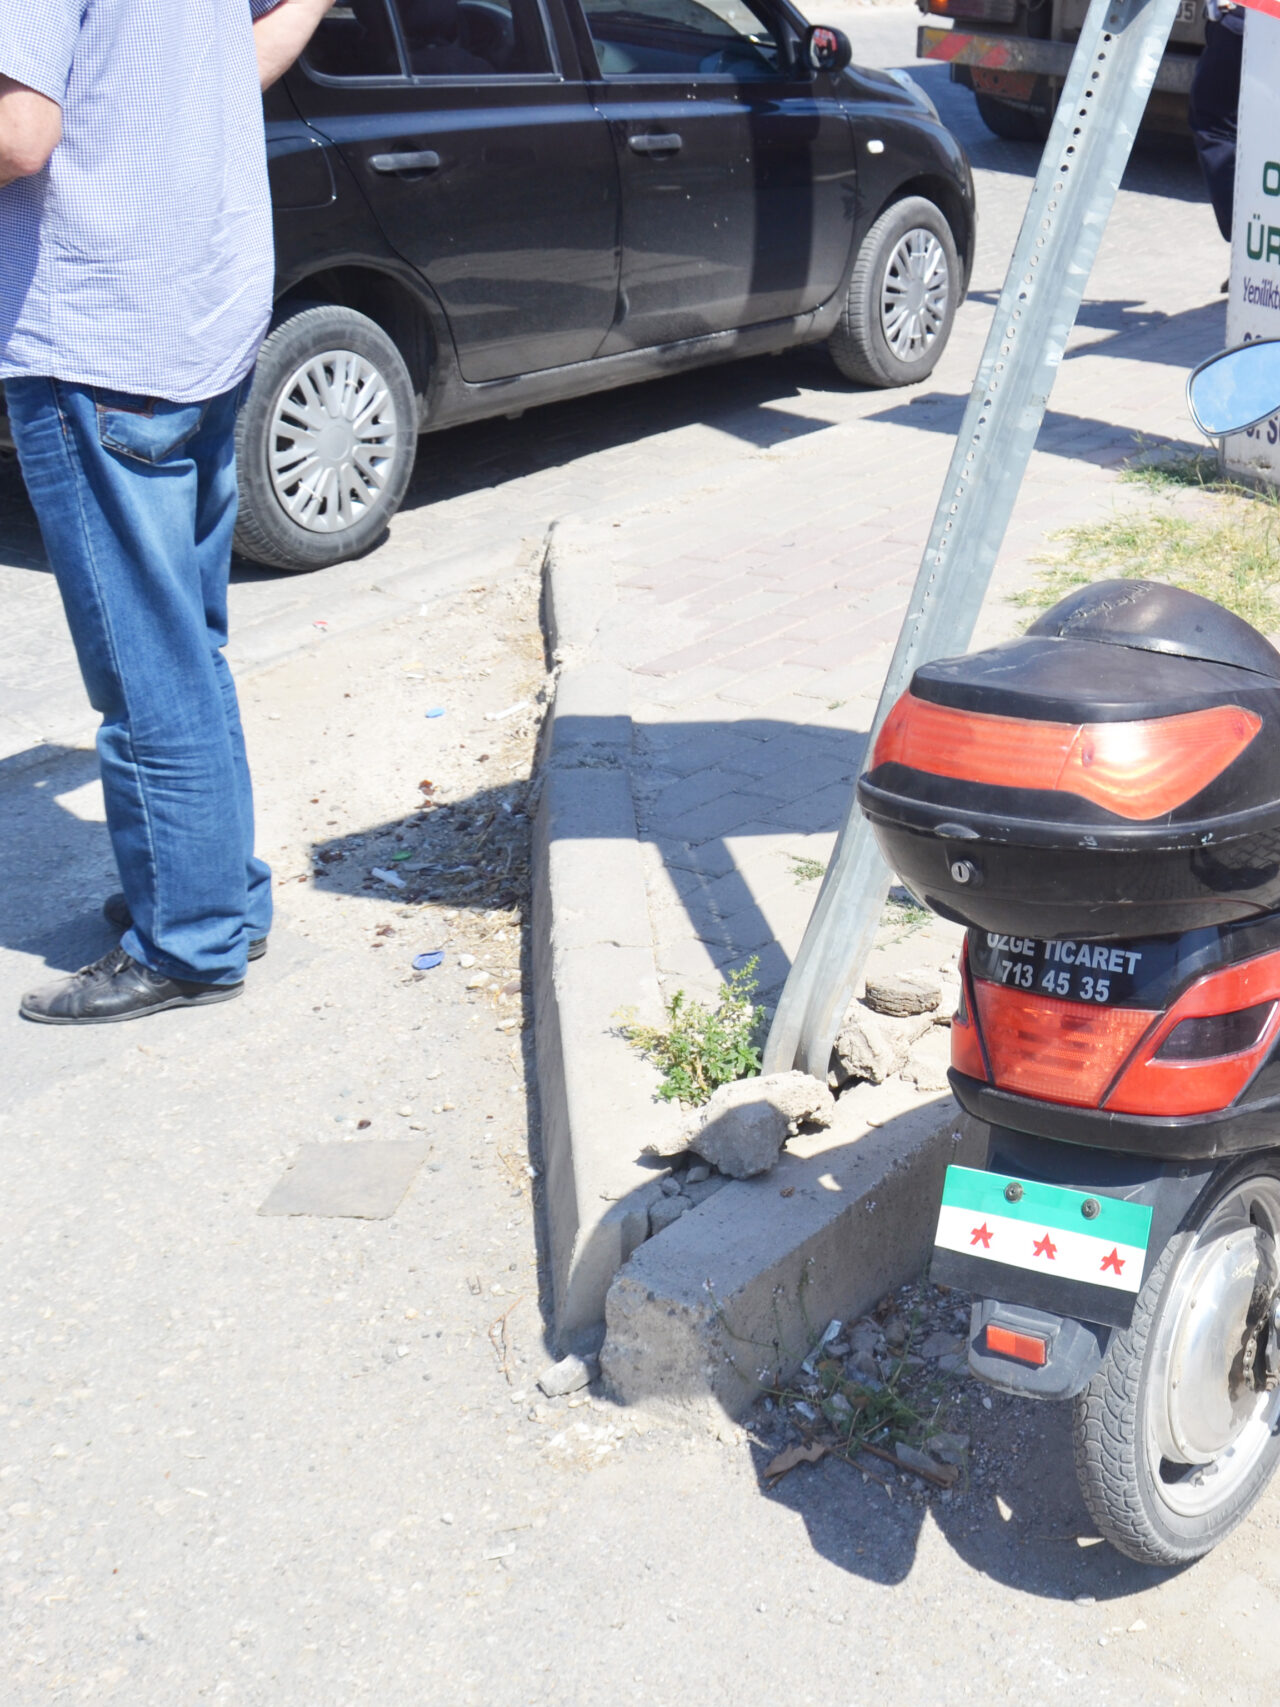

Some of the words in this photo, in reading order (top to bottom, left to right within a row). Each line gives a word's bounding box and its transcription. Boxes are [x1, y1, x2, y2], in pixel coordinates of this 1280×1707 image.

[1001, 960, 1034, 987] 713
[1042, 970, 1071, 995] 45
[1079, 976, 1111, 1002] 35
